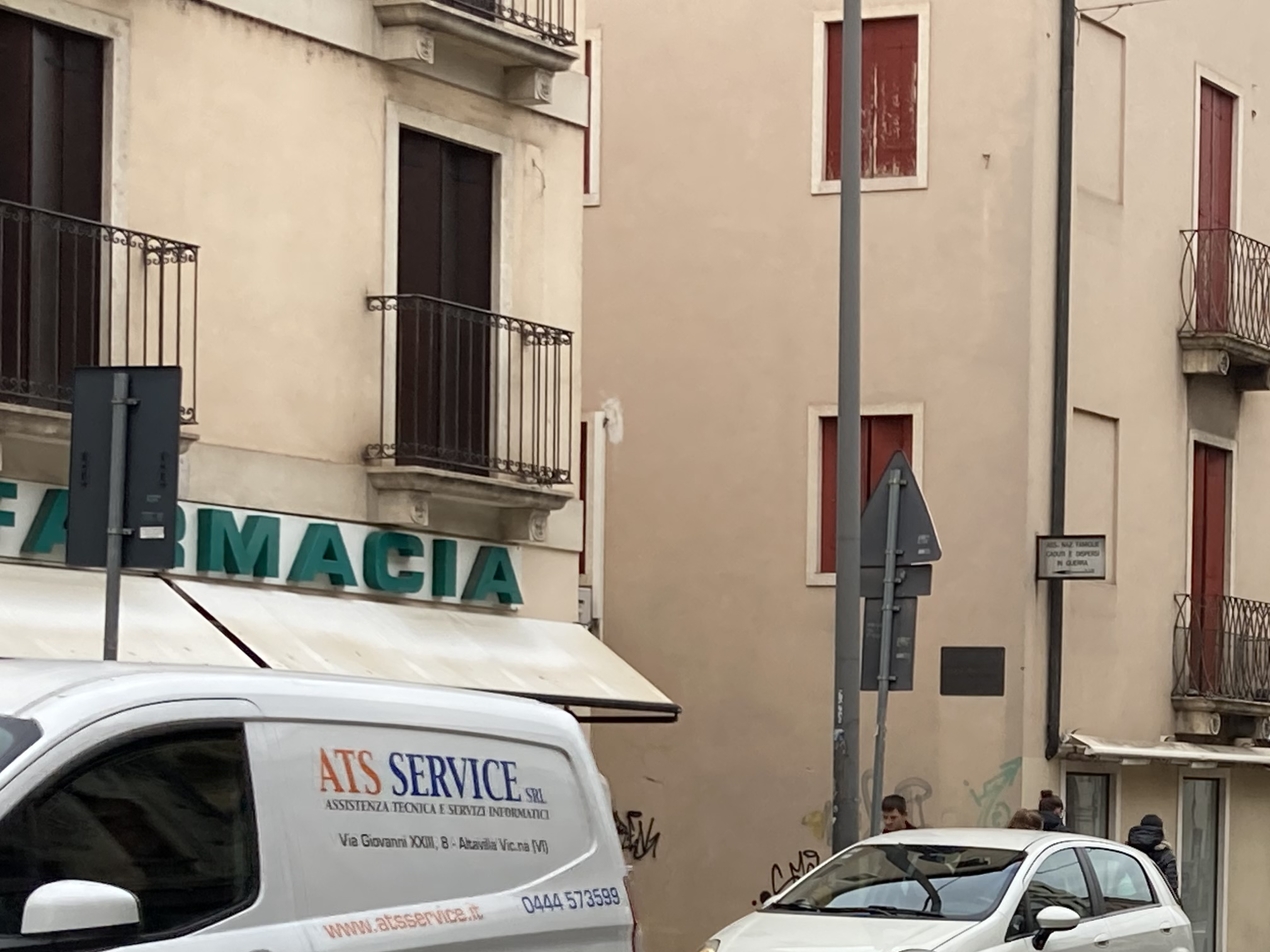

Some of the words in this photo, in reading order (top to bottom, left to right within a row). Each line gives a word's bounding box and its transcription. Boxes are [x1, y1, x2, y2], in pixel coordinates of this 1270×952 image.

[319, 747, 382, 796] ATS
[388, 751, 522, 802] SERVICE
[325, 799, 389, 813] ASSISTENZA
[391, 801, 437, 815] TECNICA
[439, 804, 446, 815] E
[449, 804, 486, 817] SERVIZI
[488, 806, 550, 820] INFORMATICI
[338, 832, 359, 848] Via
[361, 833, 408, 849] Giovanni
[441, 836, 450, 850] 8
[521, 892, 564, 915] 0444
[568, 886, 621, 910] 573599
[322, 903, 485, 940] www.atsservice.it
